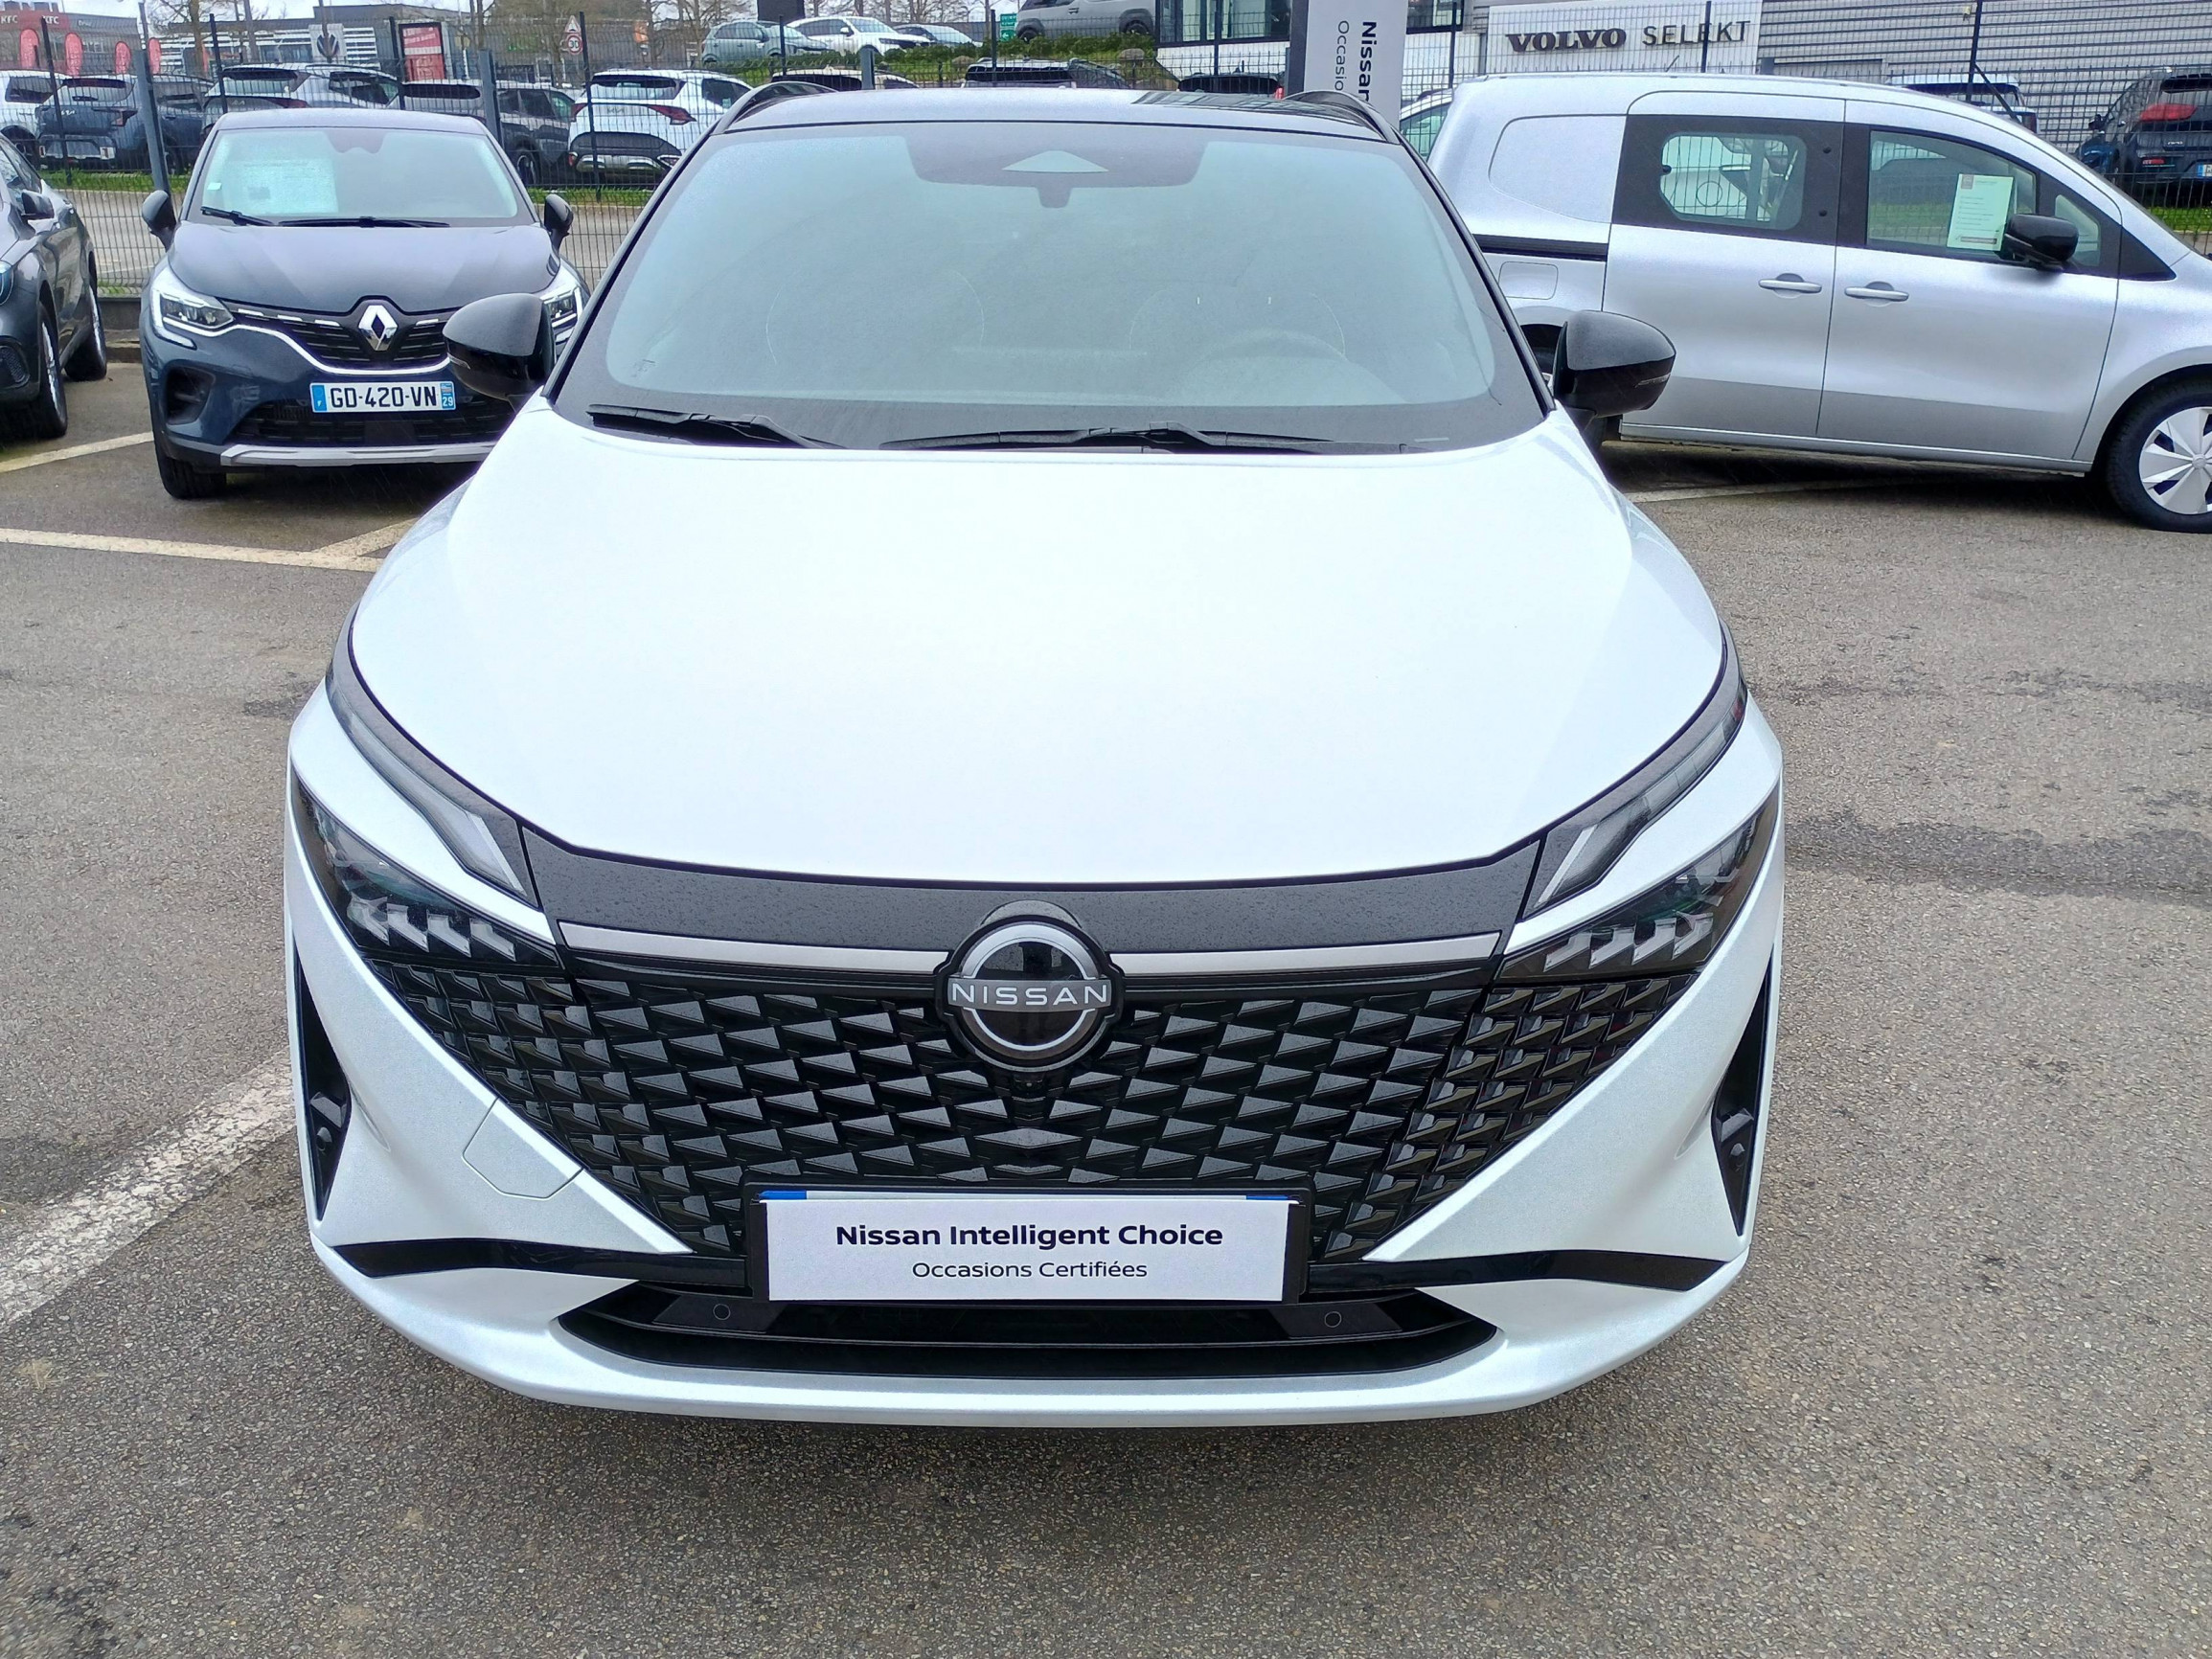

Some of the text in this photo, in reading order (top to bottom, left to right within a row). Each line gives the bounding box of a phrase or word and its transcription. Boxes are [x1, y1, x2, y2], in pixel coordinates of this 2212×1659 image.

[1, 14, 18, 24] KFC
[569, 39, 580, 49] 30
[1505, 20, 1751, 53] VOLVO SELEKT
[330, 386, 437, 408] GD-420-VN
[443, 396, 454, 407] 29
[952, 983, 1106, 1006] NISSAN
[836, 1224, 1223, 1251] Nissan Intelligent Choice
[912, 1261, 1148, 1278] Occasions Certifiées
